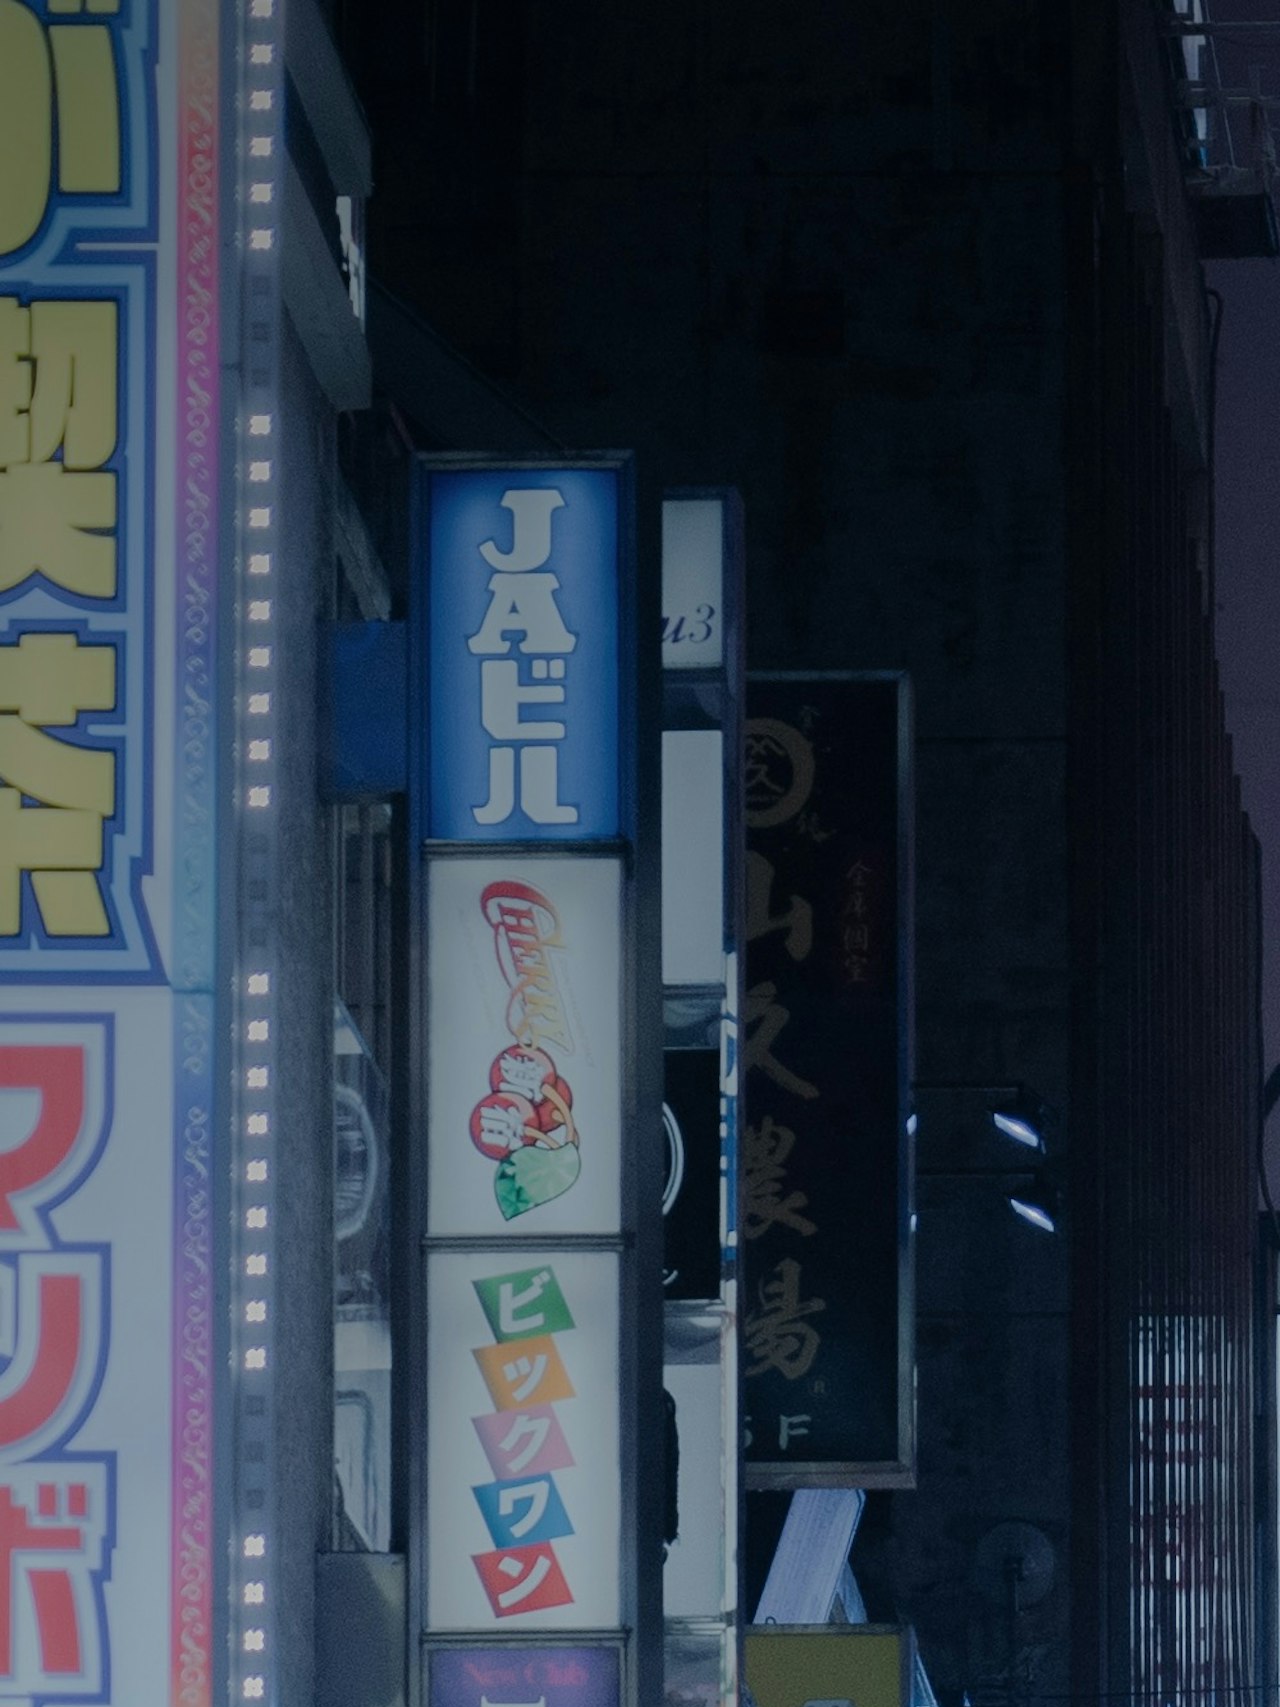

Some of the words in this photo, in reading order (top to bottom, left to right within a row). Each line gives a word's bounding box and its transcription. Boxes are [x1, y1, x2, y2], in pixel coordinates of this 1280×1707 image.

[466, 488, 578, 826] JAビル
[496, 1266, 553, 1610] ビックワン
